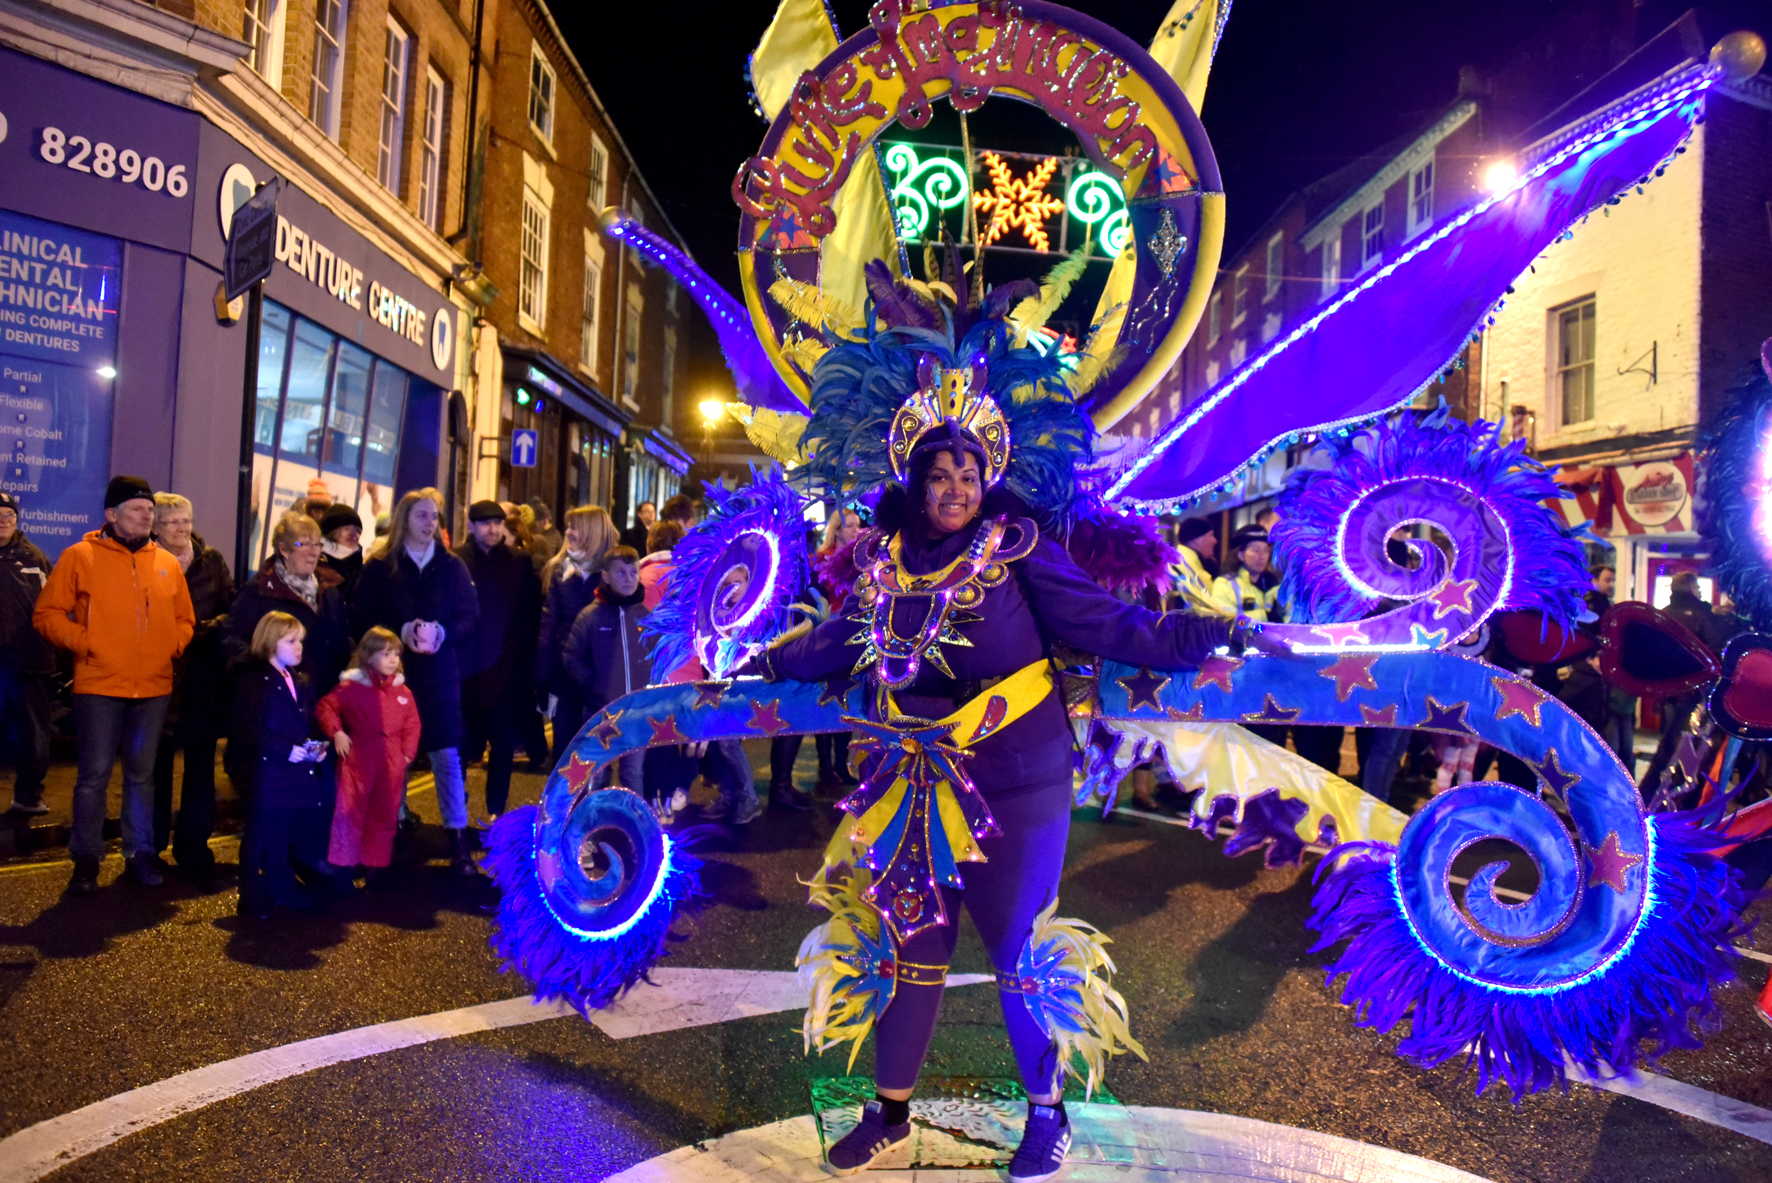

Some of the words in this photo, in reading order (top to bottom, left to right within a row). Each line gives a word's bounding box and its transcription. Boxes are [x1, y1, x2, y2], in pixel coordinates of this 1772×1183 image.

[40, 127, 189, 198] 828906
[0, 229, 89, 269] INICAL
[274, 214, 364, 311] DENTURE
[368, 280, 427, 347] CENTRE
[29, 314, 104, 339] COMPLETE
[5, 328, 80, 352] DENTURES
[4, 367, 42, 383] Partial
[0, 394, 44, 411] Flexible
[25, 426, 63, 441] Cobalt
[16, 453, 67, 468] Retained
[19, 508, 89, 523] furbishment
[21, 522, 72, 536] Dentures
